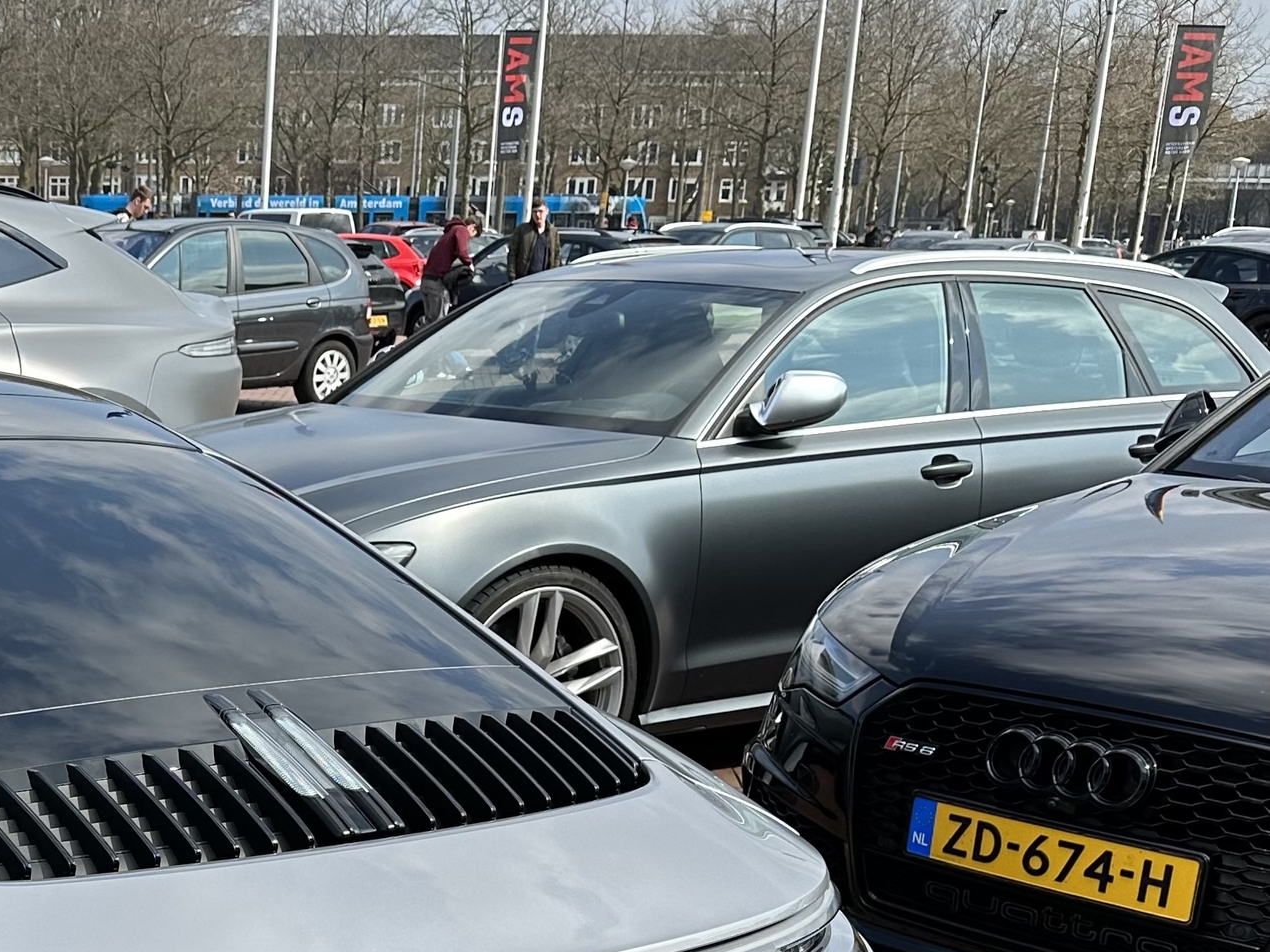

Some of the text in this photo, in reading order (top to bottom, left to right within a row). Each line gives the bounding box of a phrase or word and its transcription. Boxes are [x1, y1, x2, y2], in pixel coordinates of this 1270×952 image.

[502, 36, 534, 128] IAMS
[1168, 32, 1217, 127] IAMS
[210, 197, 252, 208] Verbid
[270, 196, 306, 208] wereld
[308, 196, 320, 208] in
[339, 197, 403, 209] Amterdam
[912, 830, 929, 847] NL
[941, 812, 1174, 908] ZD-674-H
